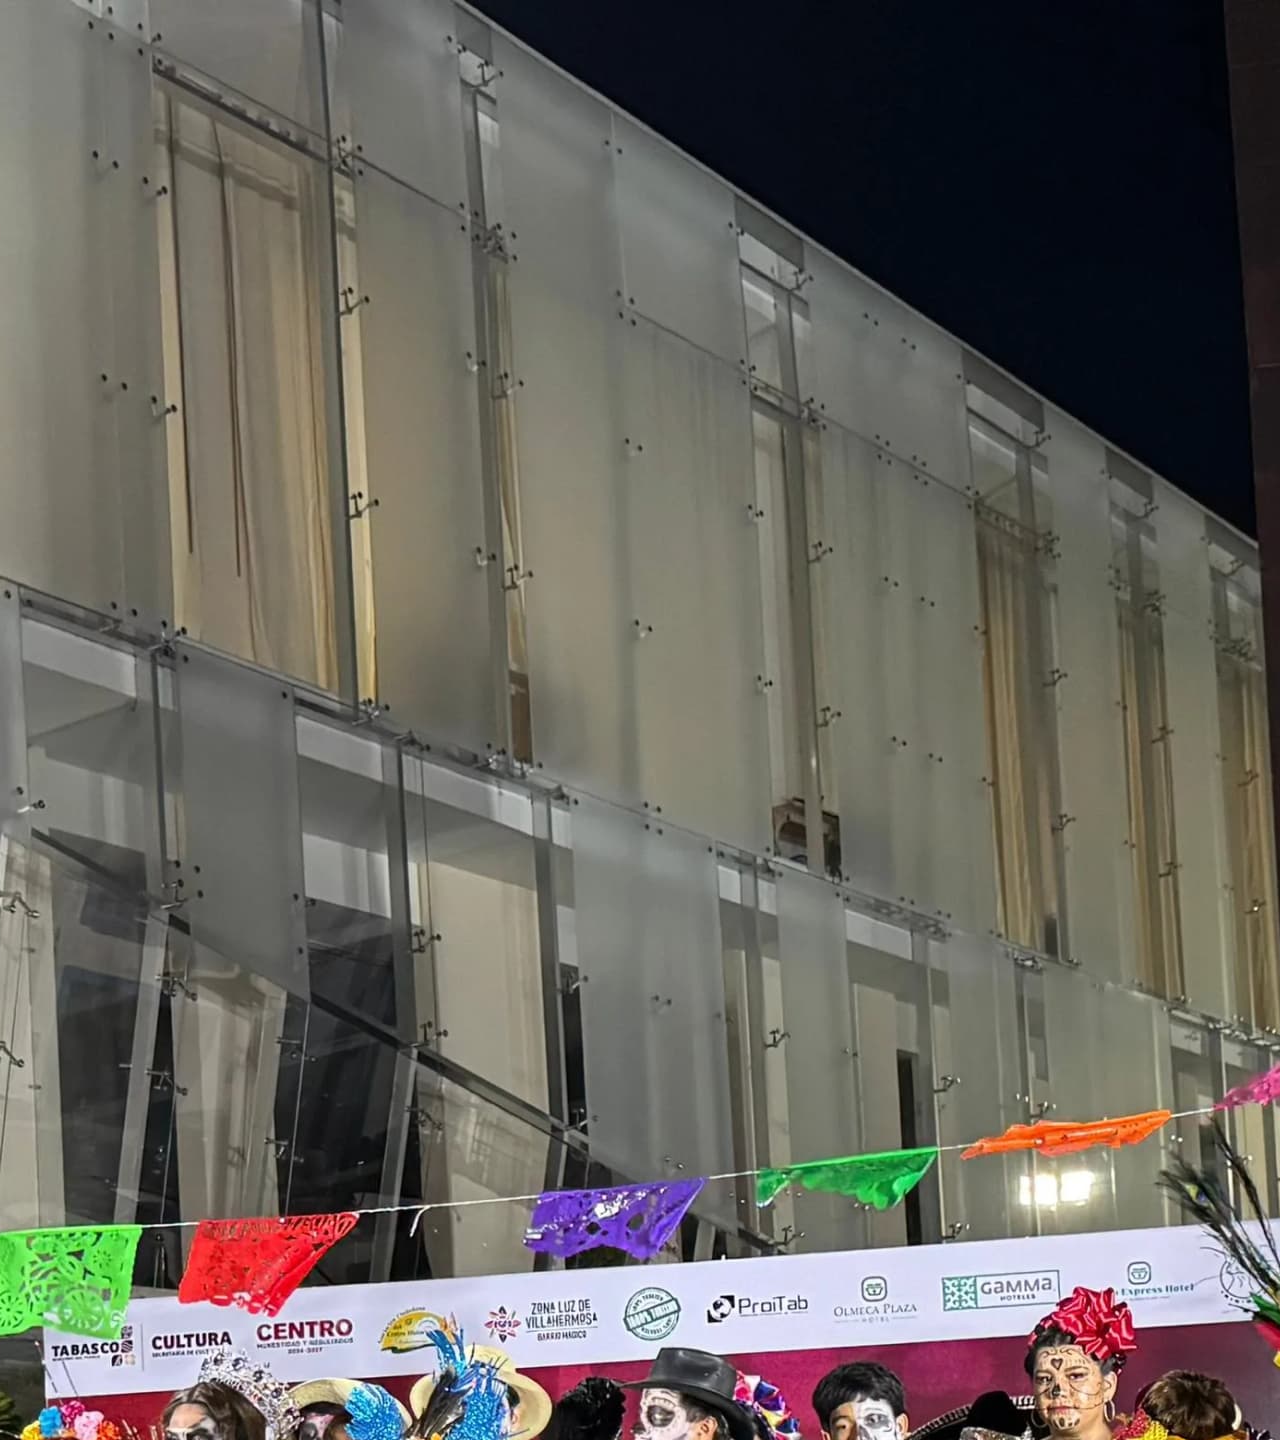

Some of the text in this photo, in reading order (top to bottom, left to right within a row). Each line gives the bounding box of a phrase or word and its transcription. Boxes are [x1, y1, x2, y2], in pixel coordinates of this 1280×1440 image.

[531, 1299, 591, 1315] ZONA LUZ DE
[525, 1312, 598, 1329] VILLAHERMOSA
[256, 1318, 353, 1341] CENTRO
[151, 1331, 232, 1350] CULTURA
[51, 1341, 120, 1358] TABASCO
